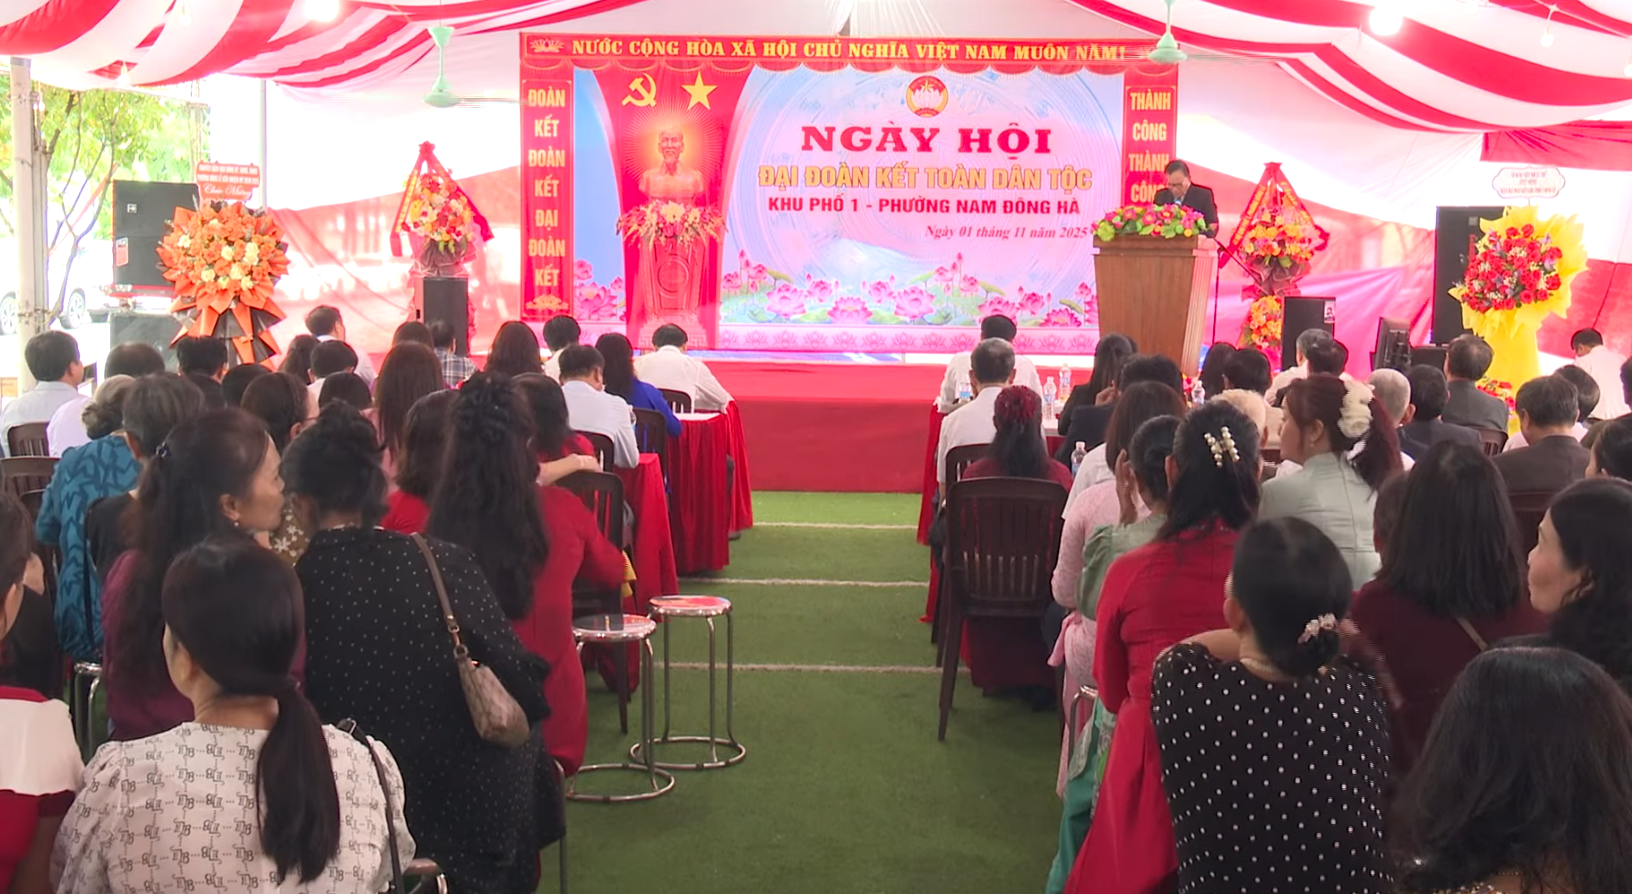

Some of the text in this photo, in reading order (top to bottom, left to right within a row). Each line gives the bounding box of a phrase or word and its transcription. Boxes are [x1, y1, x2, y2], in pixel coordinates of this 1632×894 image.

[572, 37, 1125, 61] NƯỚC CỘNG HÒA XÃ HỘI CHỦ NGHĨA VIỆT NAM MUÔN NĂM!
[528, 86, 565, 107] ĐOÀN
[1130, 89, 1171, 110] THÀNH
[534, 114, 559, 137] KẾT
[1132, 119, 1167, 141] CÔNG
[801, 121, 1051, 160] NGÀY HỘI
[528, 146, 565, 167] ĐOÀN
[1128, 150, 1169, 172] THÀNH
[534, 174, 559, 197] KẾT
[758, 160, 1093, 195] ĐẠI ĐOÀN KẾT TOÀN DÂN TỘC
[1130, 181, 1165, 203] CÔN
[768, 197, 803, 211] KHU
[809, 193, 844, 212] PHỐ
[850, 199, 858, 212] 1
[879, 196, 950, 213] PHƯỜNG
[956, 199, 996, 214] NAM
[1003, 197, 1050, 214] ĐÔNG
[1057, 198, 1080, 214] HÀ
[535, 209, 558, 231] ĐẠI
[925, 225, 1088, 239] Ngày 01 tháng 11 năm 2025
[528, 235, 565, 257] ĐOÀN
[534, 263, 559, 287] KẾT
